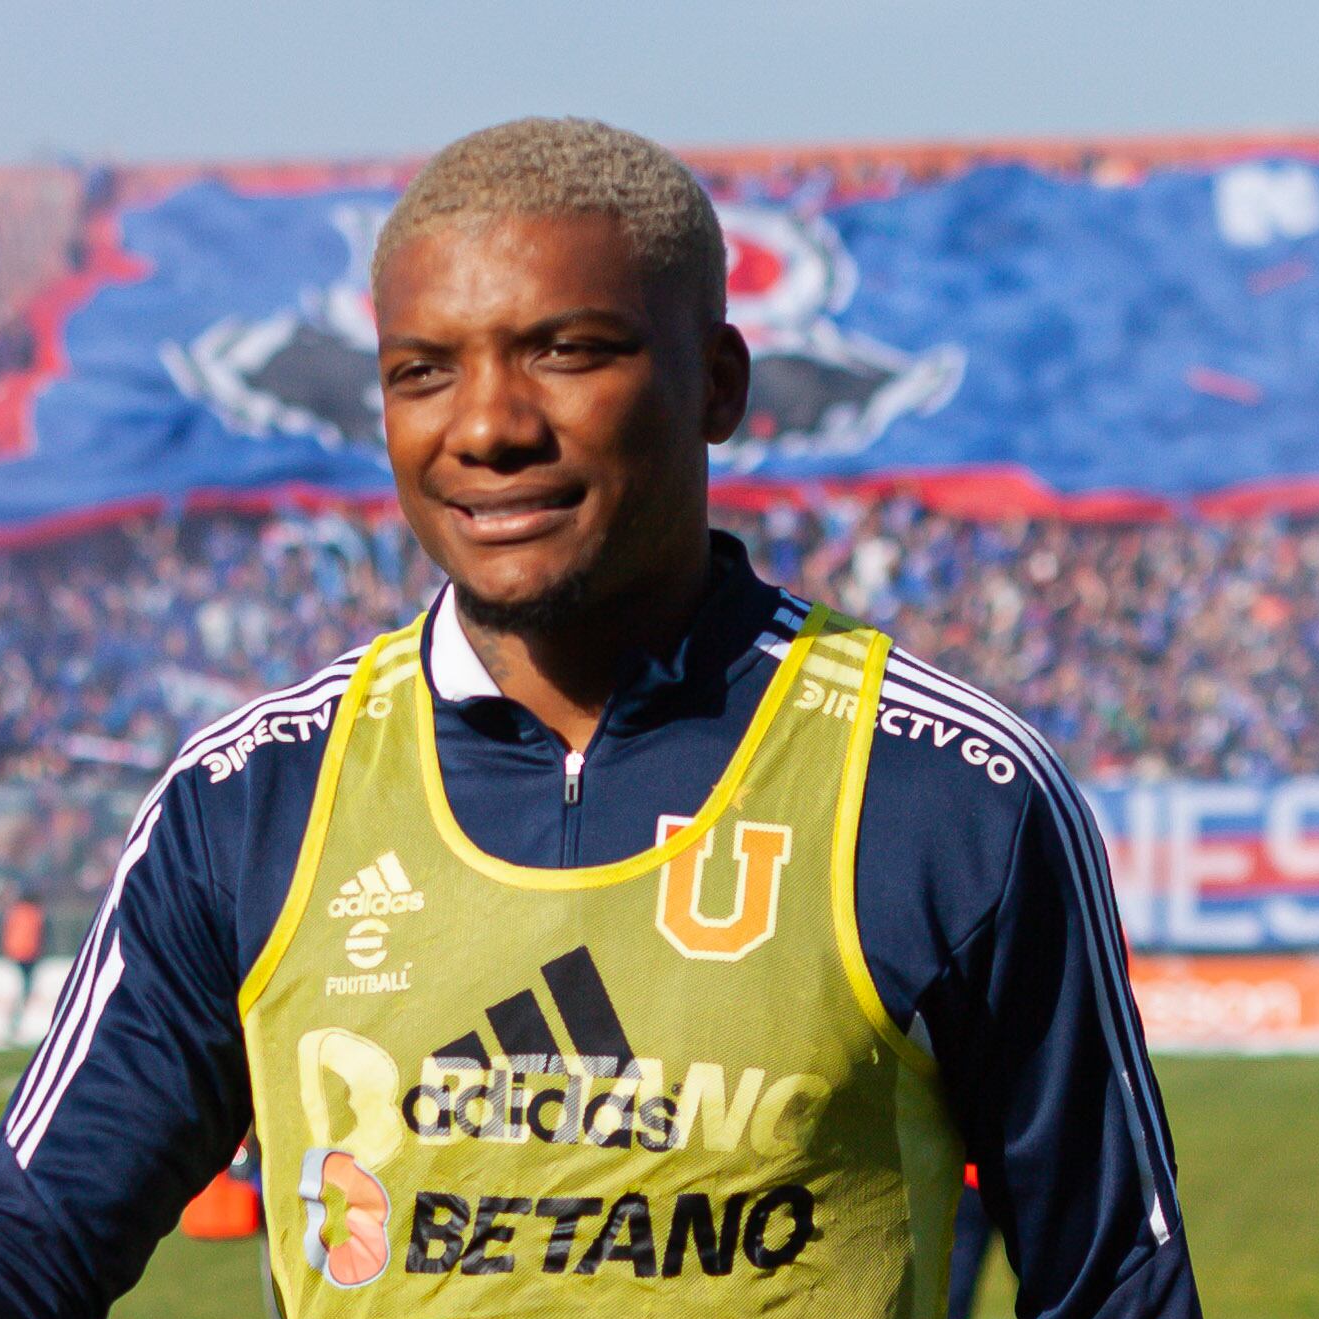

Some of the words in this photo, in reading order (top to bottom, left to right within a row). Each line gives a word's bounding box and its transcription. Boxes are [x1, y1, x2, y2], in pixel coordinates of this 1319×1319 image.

[200, 700, 332, 784] DIRECTV
[793, 678, 962, 748] DIRCTV
[960, 737, 1016, 785] GO
[327, 890, 425, 918] adidas
[655, 814, 793, 962] U
[325, 969, 413, 997] FOOTBALL
[402, 1068, 681, 1153] adidas
[404, 1184, 821, 1278] BETANO
